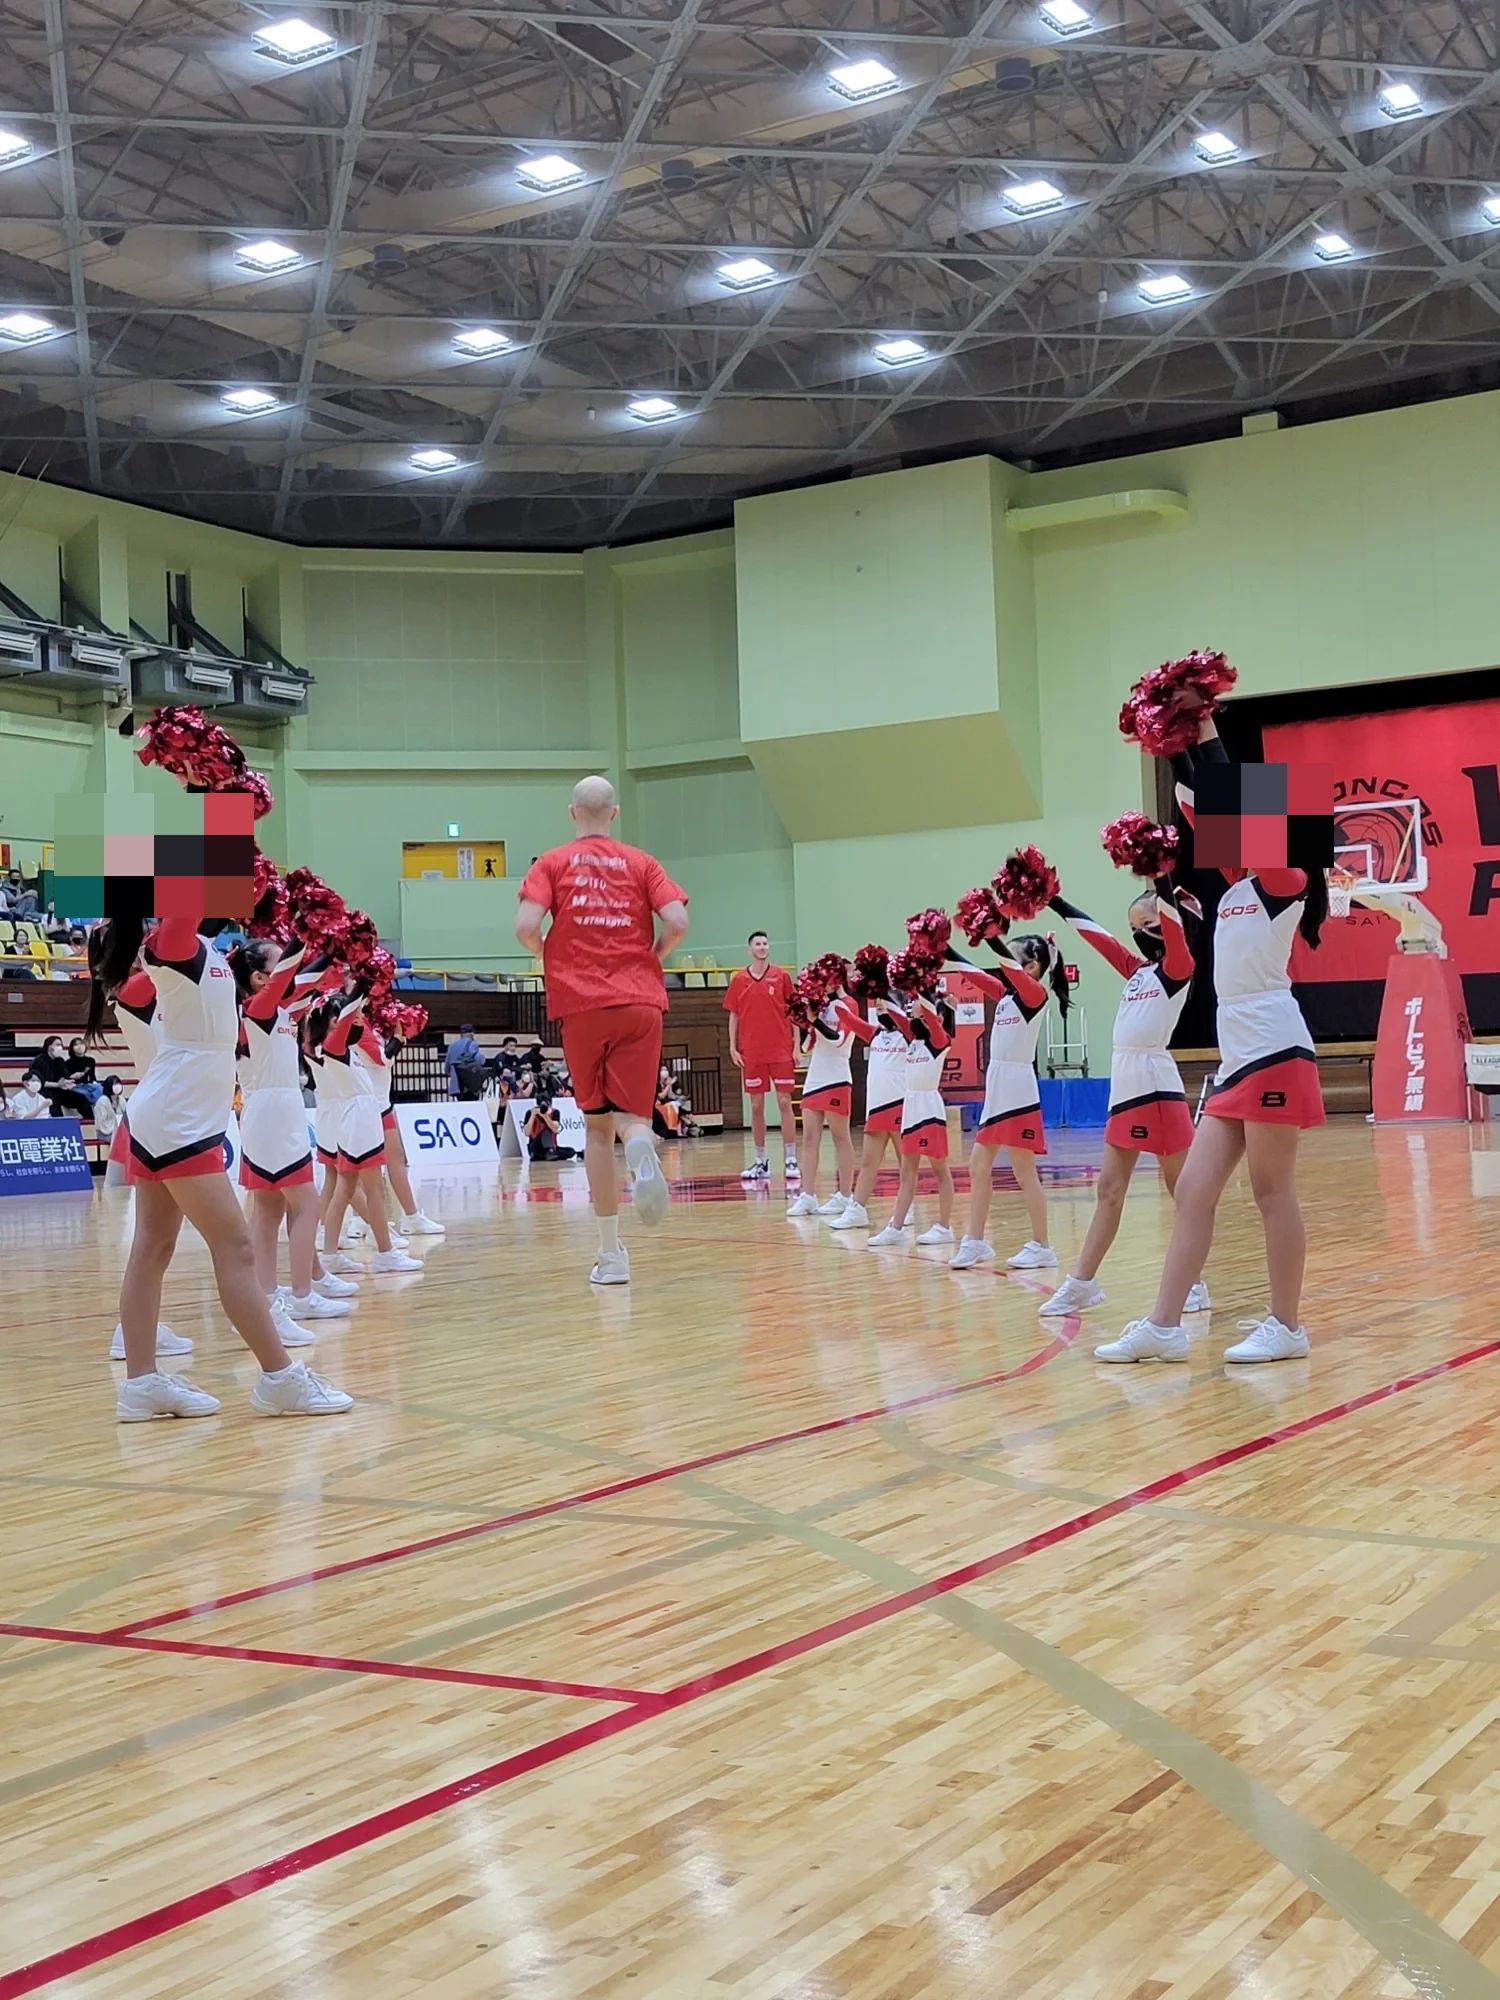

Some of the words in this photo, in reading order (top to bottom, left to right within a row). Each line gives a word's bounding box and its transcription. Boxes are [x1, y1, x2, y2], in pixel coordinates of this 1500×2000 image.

[1220, 904, 1259, 919] COS
[0, 1136, 85, 1164] 田電業社
